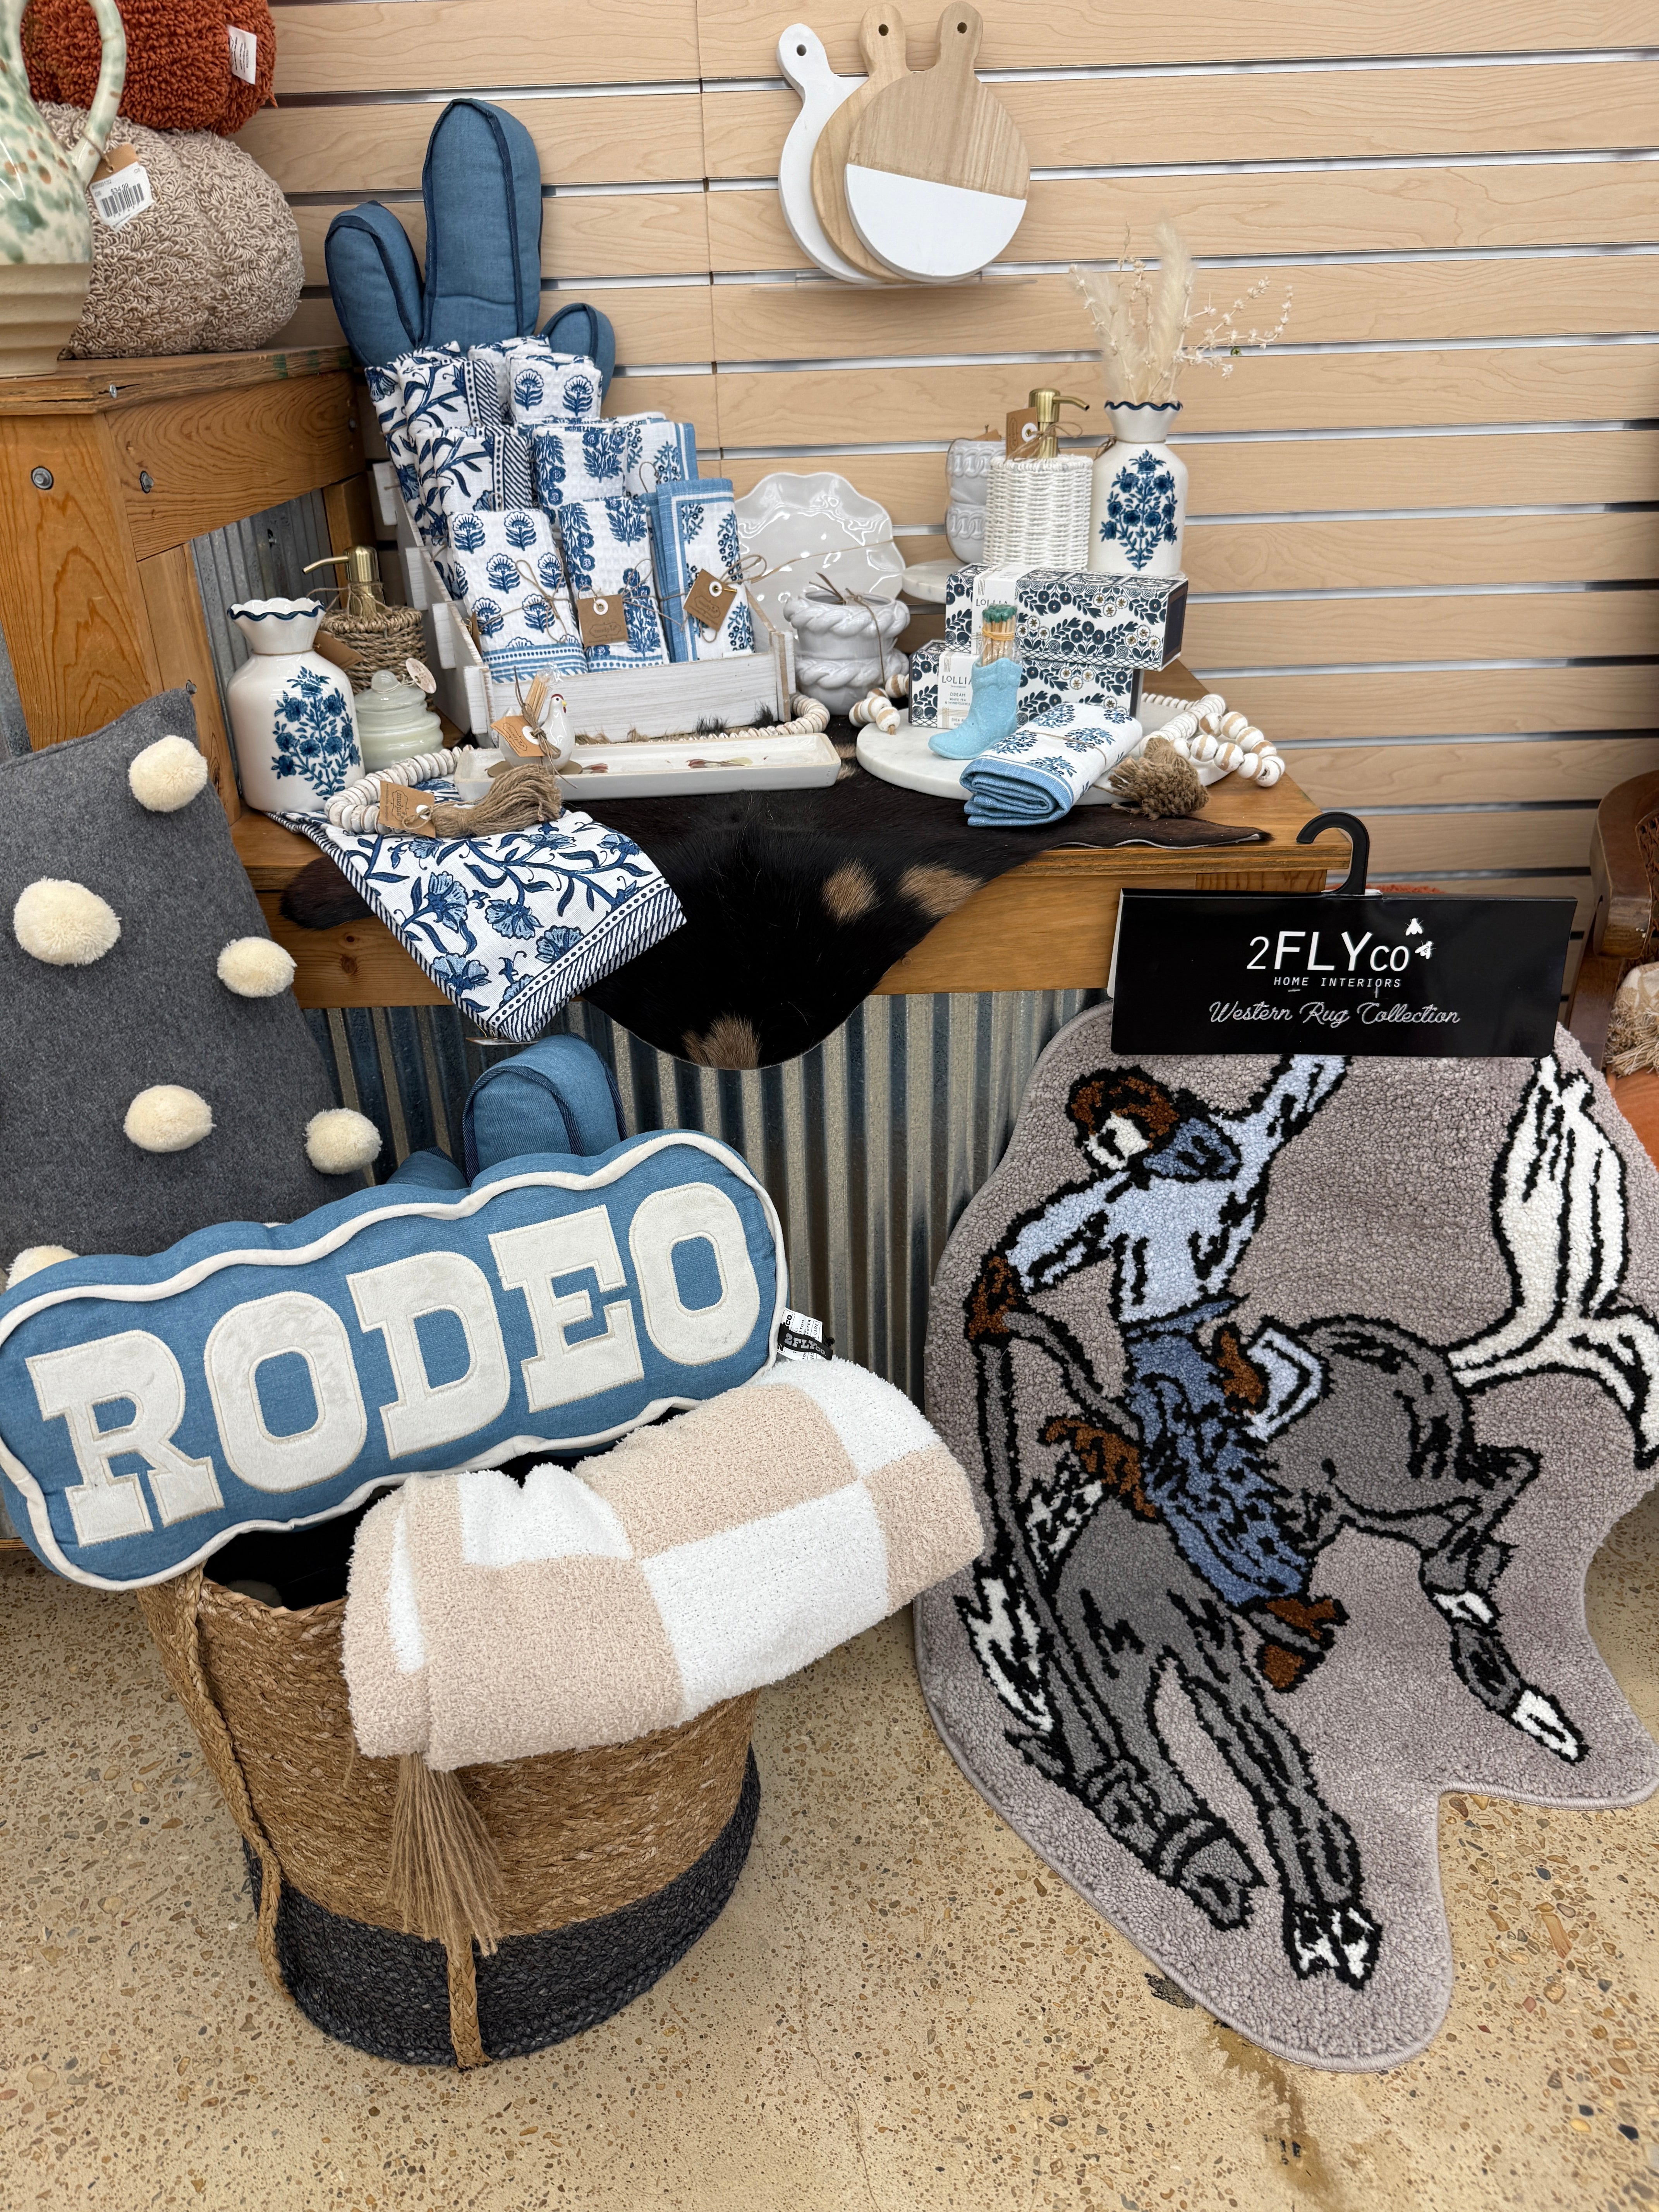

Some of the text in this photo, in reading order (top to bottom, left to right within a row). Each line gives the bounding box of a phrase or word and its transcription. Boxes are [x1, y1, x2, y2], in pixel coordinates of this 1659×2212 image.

[1274, 977, 1402, 988] HOME INTERIORS
[1209, 1001, 1461, 1028] Western Rug Collection
[26, 1182, 761, 1547] RODEO
